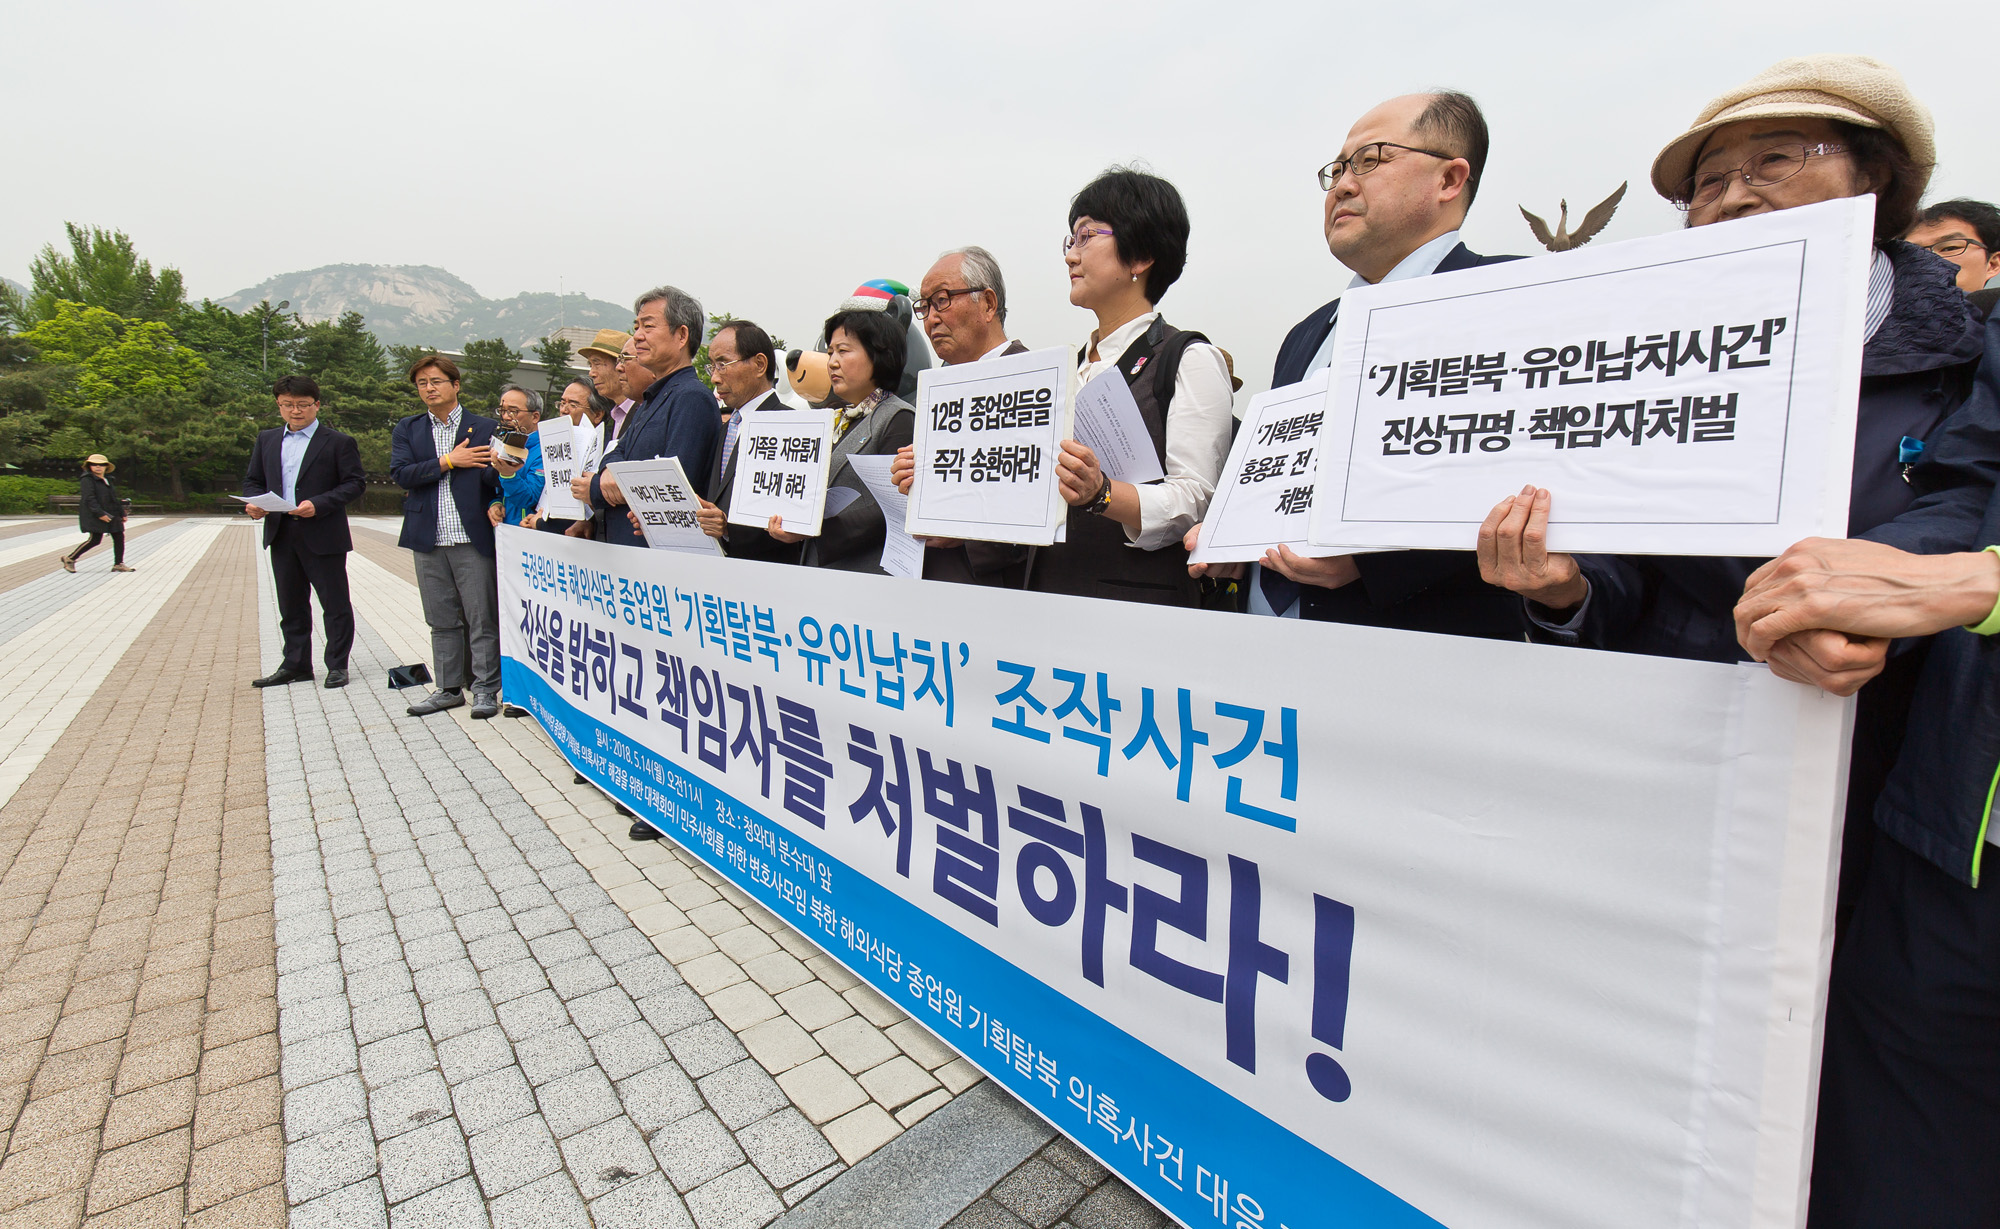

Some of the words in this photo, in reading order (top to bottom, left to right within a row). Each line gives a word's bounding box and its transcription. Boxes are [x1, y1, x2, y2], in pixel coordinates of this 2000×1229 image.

[931, 397, 964, 433] 12명
[968, 387, 1052, 432] 종업원들을
[748, 435, 778, 460] 가족을
[780, 436, 821, 464] 자유롭게
[933, 447, 965, 482] 즉각
[969, 444, 1041, 483] 송환하라!
[1239, 454, 1289, 485] 홍용표
[1289, 447, 1314, 476] 전
[650, 485, 671, 503] 가는
[665, 484, 687, 502] 줄도
[753, 471, 784, 497] 만나게
[785, 473, 806, 500] 하라
[1274, 484, 1314, 515] 처벌
[641, 511, 668, 526] 모르고
[521, 551, 557, 597] 국정원의
[556, 560, 568, 601] 북
[568, 564, 617, 619] 해외식당
[618, 577, 673, 637] 종업원
[991, 659, 1299, 834] 조작사건
[520, 598, 565, 686] 진실을
[568, 618, 648, 721] 밝히고
[655, 648, 834, 831] 책임자를
[846, 722, 1355, 1104] 처벌하라!
[743, 815, 776, 858] 청와대
[778, 837, 816, 883] 분수대
[818, 862, 832, 894] 앞
[608, 761, 628, 790] 해결을
[629, 775, 643, 800] 위한
[644, 784, 675, 824] 대책회의
[681, 808, 725, 858] 민주사회를
[726, 840, 748, 874] 위한
[749, 856, 807, 916] 변호사모임
[809, 895, 837, 937] 북한
[840, 916, 904, 983] 해외식당
[906, 961, 963, 1029] 종업원
[968, 1003, 1061, 1098] 기획탈북
[1066, 1075, 1184, 1192] 의혹사건
[1196, 1164, 1265, 1229] 대응
